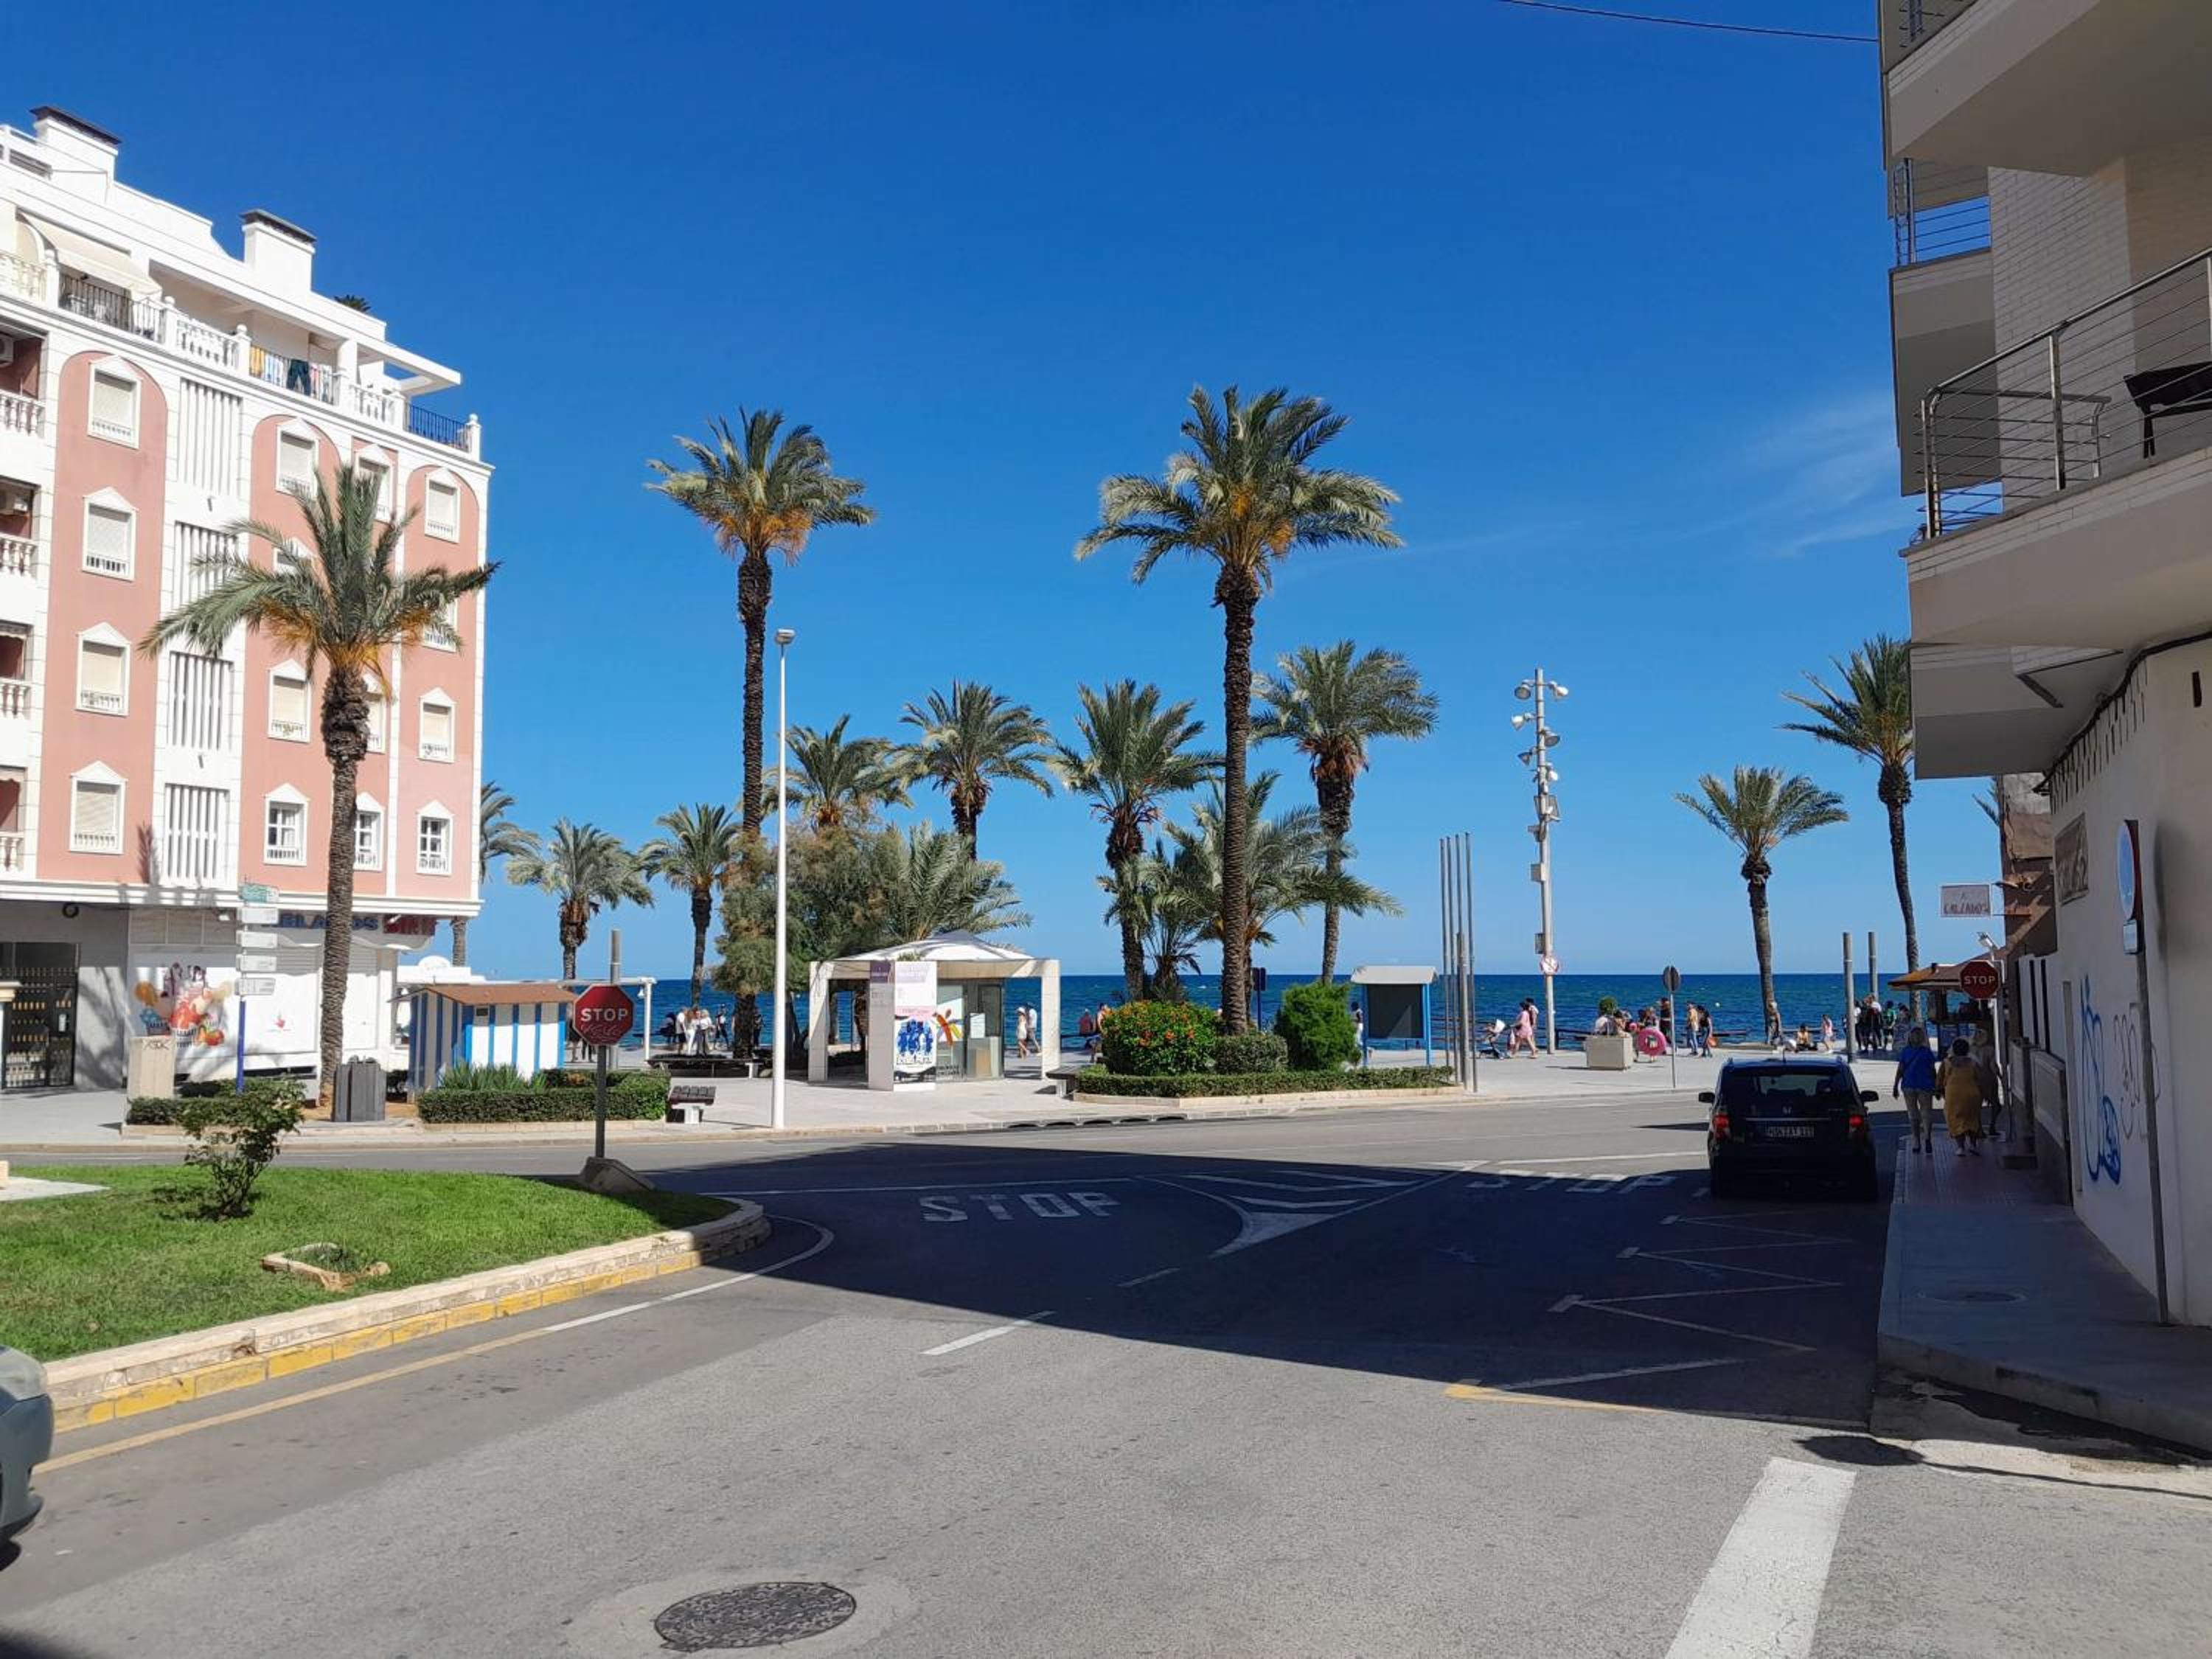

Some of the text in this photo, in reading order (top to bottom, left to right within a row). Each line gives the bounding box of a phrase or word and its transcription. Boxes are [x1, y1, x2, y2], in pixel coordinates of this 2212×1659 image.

[1963, 975, 1996, 984] STOP
[580, 1008, 629, 1022] STOP
[919, 1192, 1120, 1221] STOP
